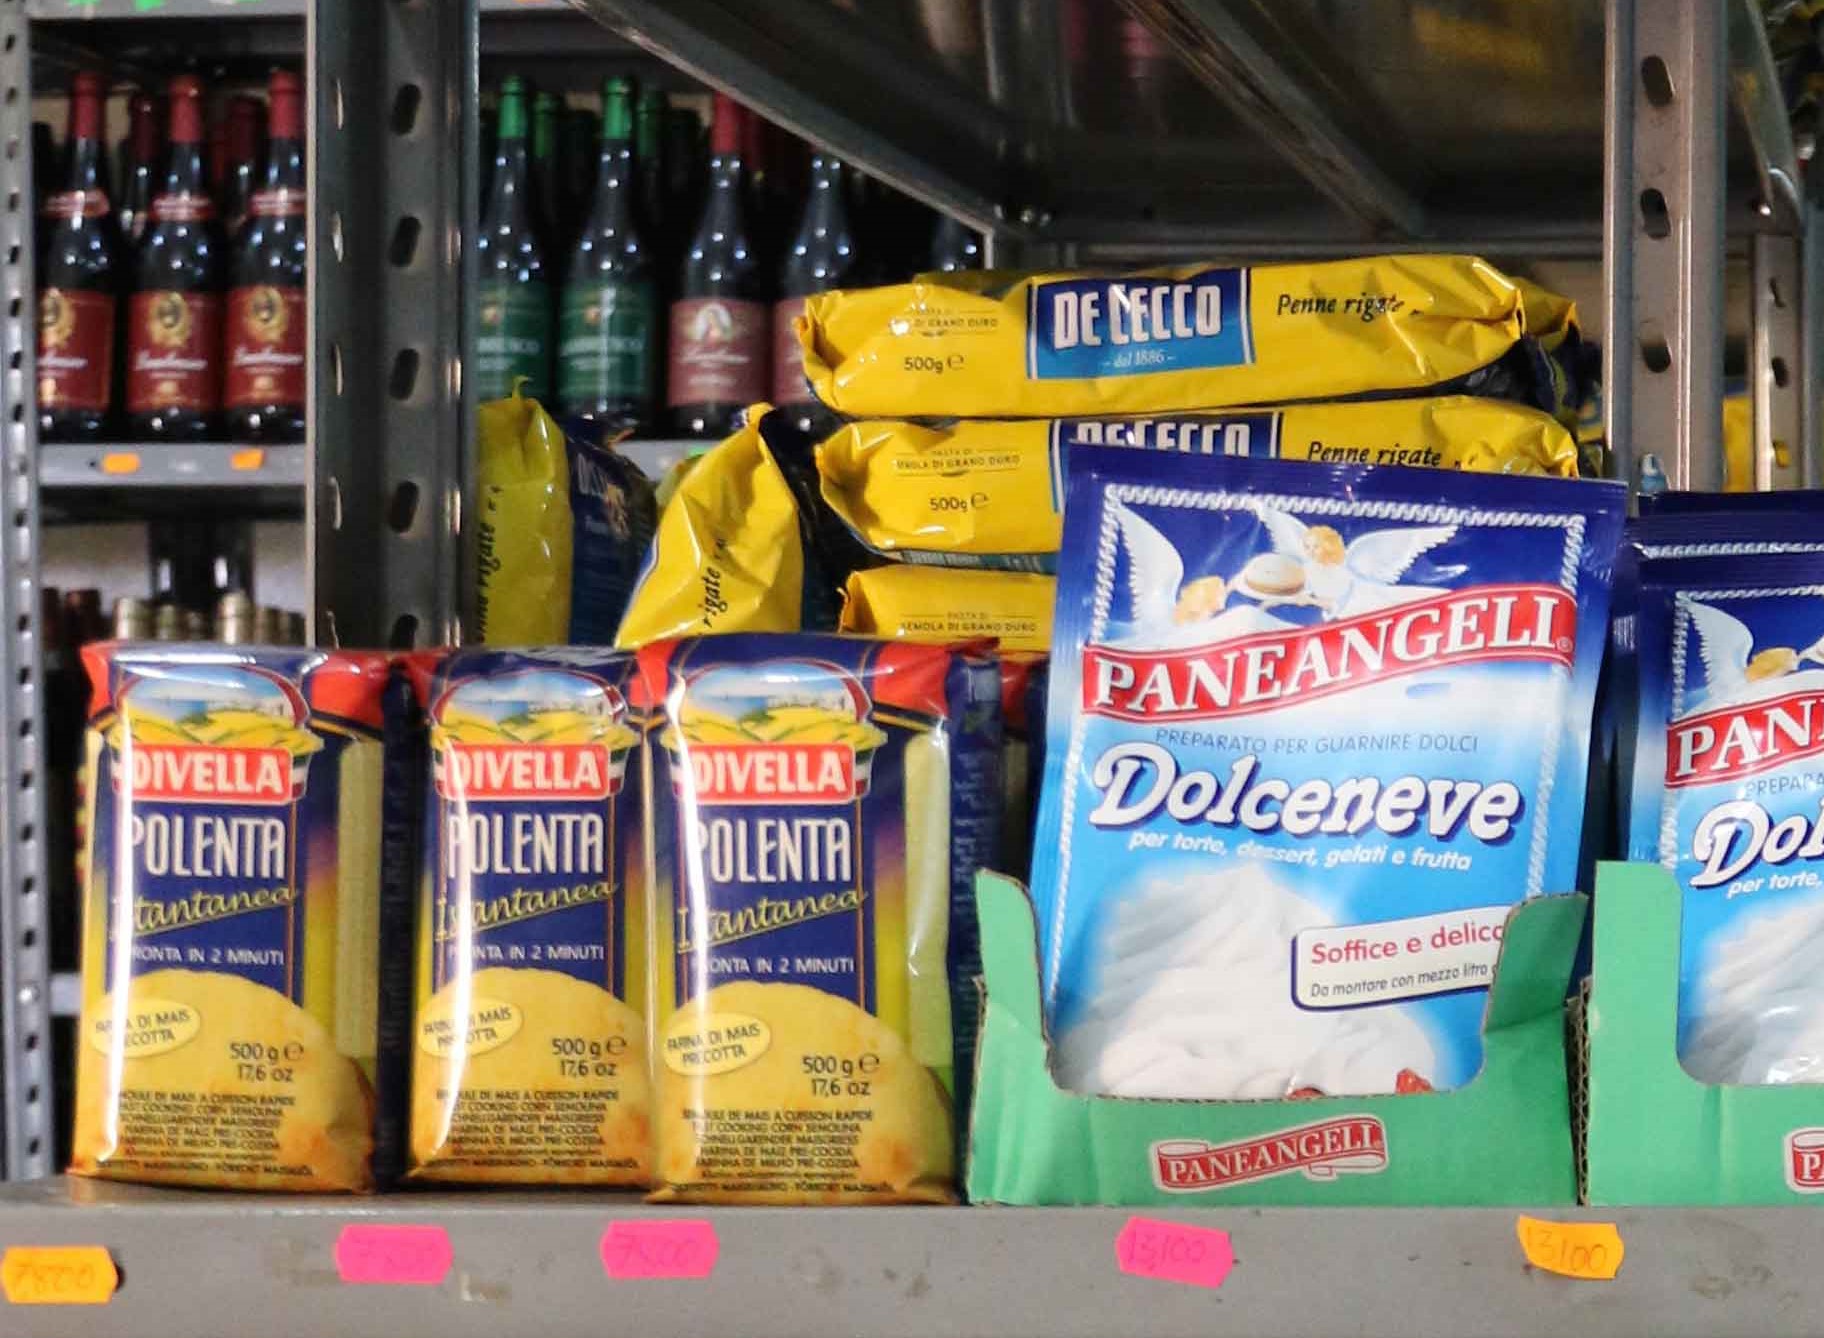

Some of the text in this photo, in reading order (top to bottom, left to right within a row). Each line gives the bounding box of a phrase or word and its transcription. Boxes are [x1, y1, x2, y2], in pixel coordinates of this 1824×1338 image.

[1054, 285, 1221, 350] DE CECCO
[1278, 294, 1336, 315] Penne
[904, 356, 944, 373] 500g
[1133, 349, 1164, 365] 1886
[1308, 442, 1442, 466] Penne rigate
[930, 497, 968, 513] 500g
[704, 566, 728, 627] rigate
[963, 622, 1037, 631] GRANO DURO
[1092, 594, 1560, 714] PANEANGELI
[1157, 727, 1479, 755] PREPARATO PER GUARNIRE DOLCI
[129, 752, 285, 794] DIVELLA
[453, 750, 601, 790] DIVELLA
[692, 752, 848, 794] DIVELLA
[1088, 739, 1525, 843] Dolceneve
[448, 813, 604, 878] POLENTA
[1129, 831, 1472, 871] per torte, gelati e frutta
[1728, 878, 1764, 899] per
[1769, 873, 1823, 891] torte,
[188, 947, 284, 965] IN 2 MINUTI
[510, 945, 604, 960] IN 2 MINUTI
[1311, 936, 1423, 965] Soffice e
[758, 957, 855, 974] IN 2 MINUTI
[1311, 963, 1488, 998] Da montare con mezzo litro
[726, 1024, 761, 1041] MAIS
[230, 1042, 264, 1061] 500
[553, 1037, 586, 1055] 500
[802, 1056, 838, 1075] 500
[1169, 1123, 1382, 1182] PANEANGELI
